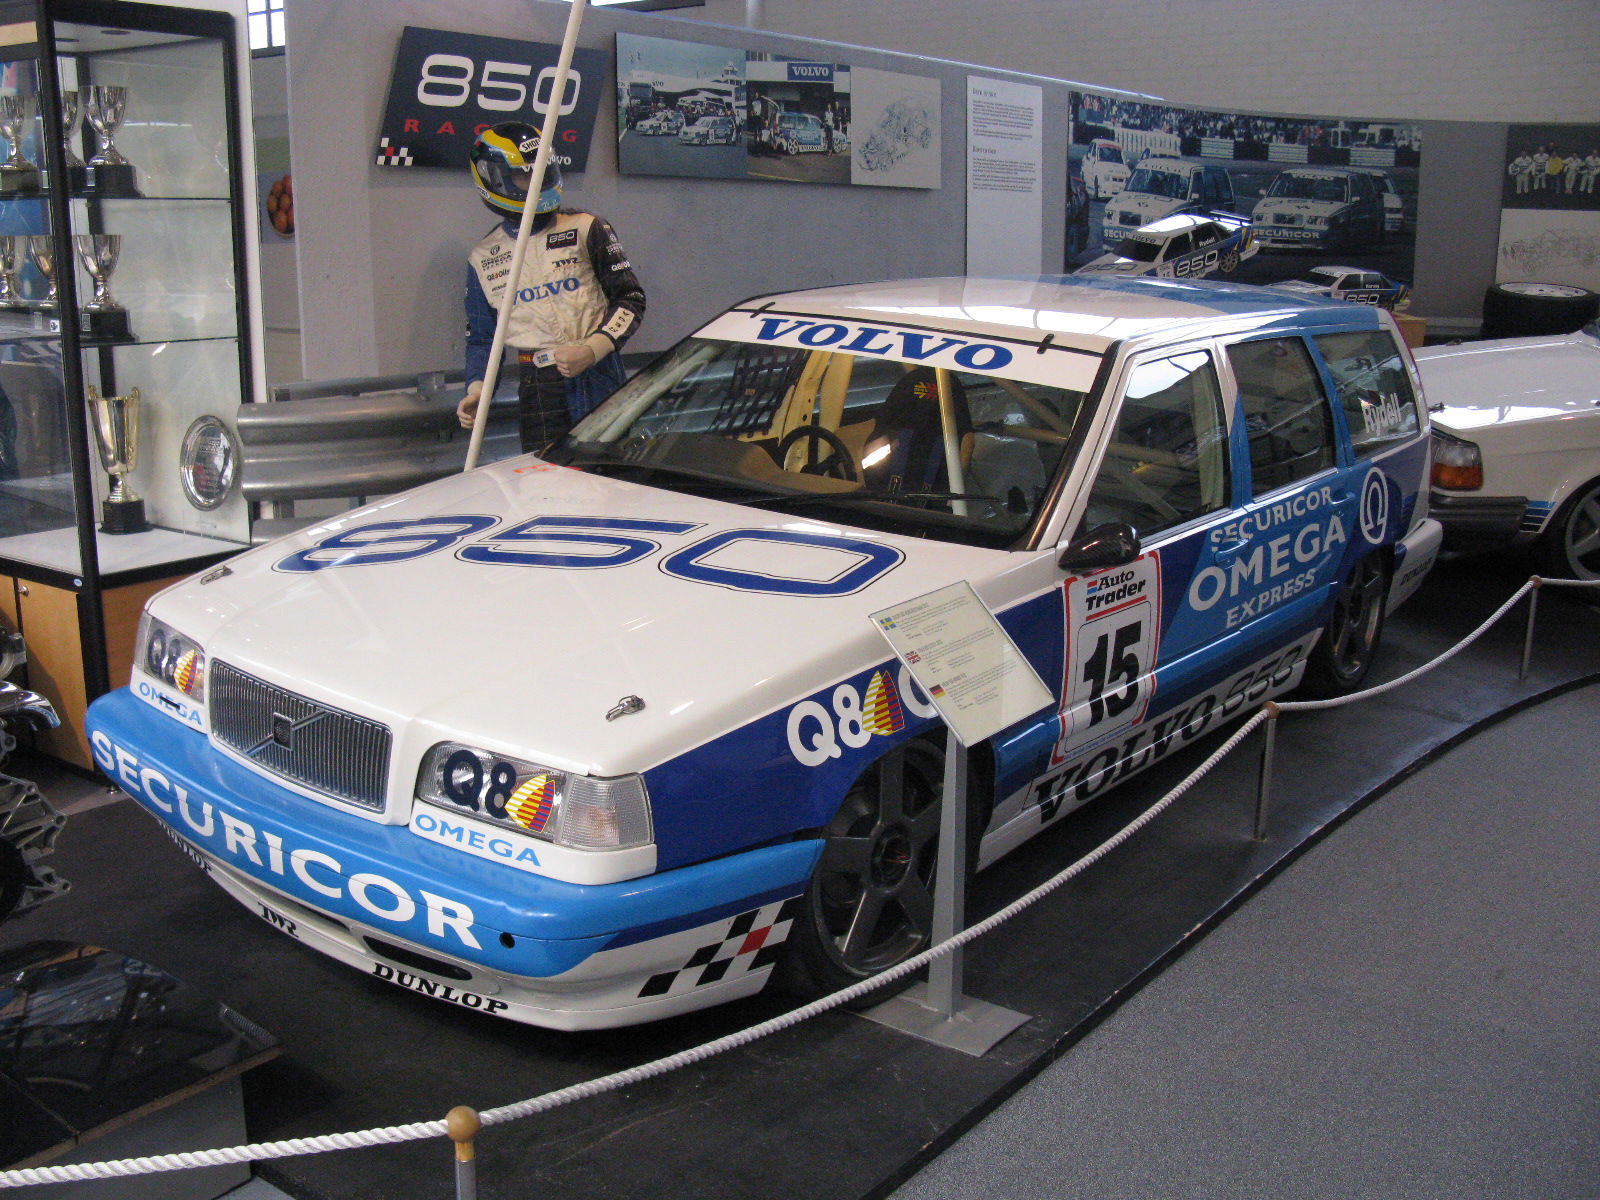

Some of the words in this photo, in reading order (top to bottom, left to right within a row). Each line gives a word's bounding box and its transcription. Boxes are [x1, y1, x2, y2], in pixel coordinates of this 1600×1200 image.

[417, 53, 581, 116] 850
[792, 66, 829, 77] VOLVO
[549, 231, 575, 243] 850
[1175, 250, 1218, 276] 850
[757, 317, 1013, 371] VOLVO
[1210, 486, 1333, 552] SECURICOR
[272, 515, 906, 599] 850
[1098, 570, 1135, 590] Auto
[1188, 516, 1346, 611] OMEGA
[1086, 578, 1146, 611] Trader
[1225, 568, 1316, 628] EXPRESS
[146, 628, 181, 683] Q8
[1082, 620, 1143, 728] 15
[138, 681, 202, 725] OMEGA
[786, 683, 871, 767] Q8
[1035, 694, 1216, 824] VOLVO
[1222, 645, 1303, 717] 850
[443, 749, 517, 820] Q8
[92, 730, 485, 951] SECURICOR
[415, 814, 542, 867] OMEGA
[257, 902, 299, 938] TWR
[372, 962, 509, 1014] DUNLOP
